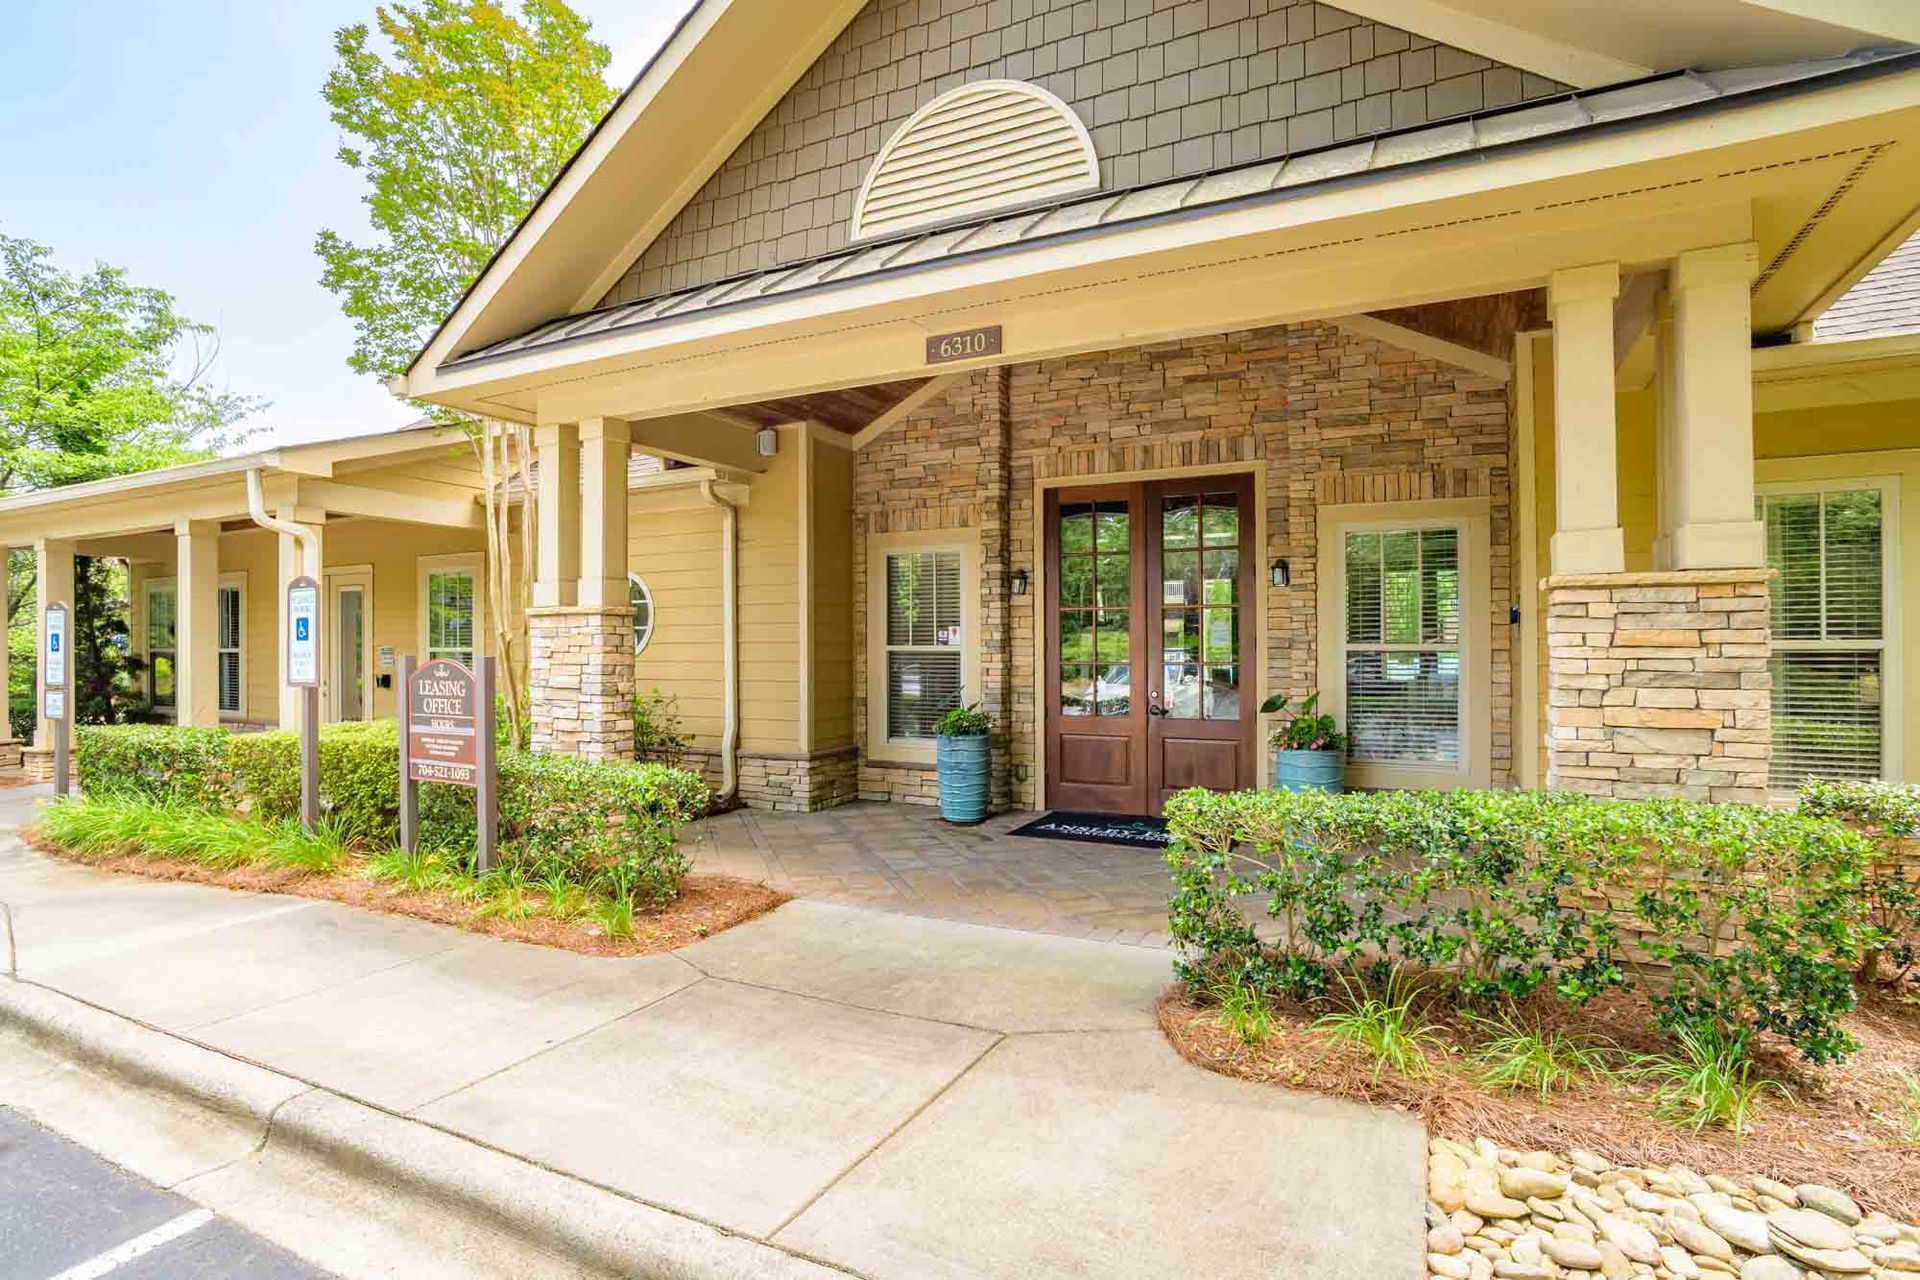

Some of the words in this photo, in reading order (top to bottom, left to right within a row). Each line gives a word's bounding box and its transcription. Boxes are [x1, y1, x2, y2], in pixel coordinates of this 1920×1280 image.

[940, 333, 985, 357] 6310
[418, 680, 466, 697] LEASING
[423, 697, 462, 714] OFFICE
[417, 765, 470, 780] 704-521-1093
